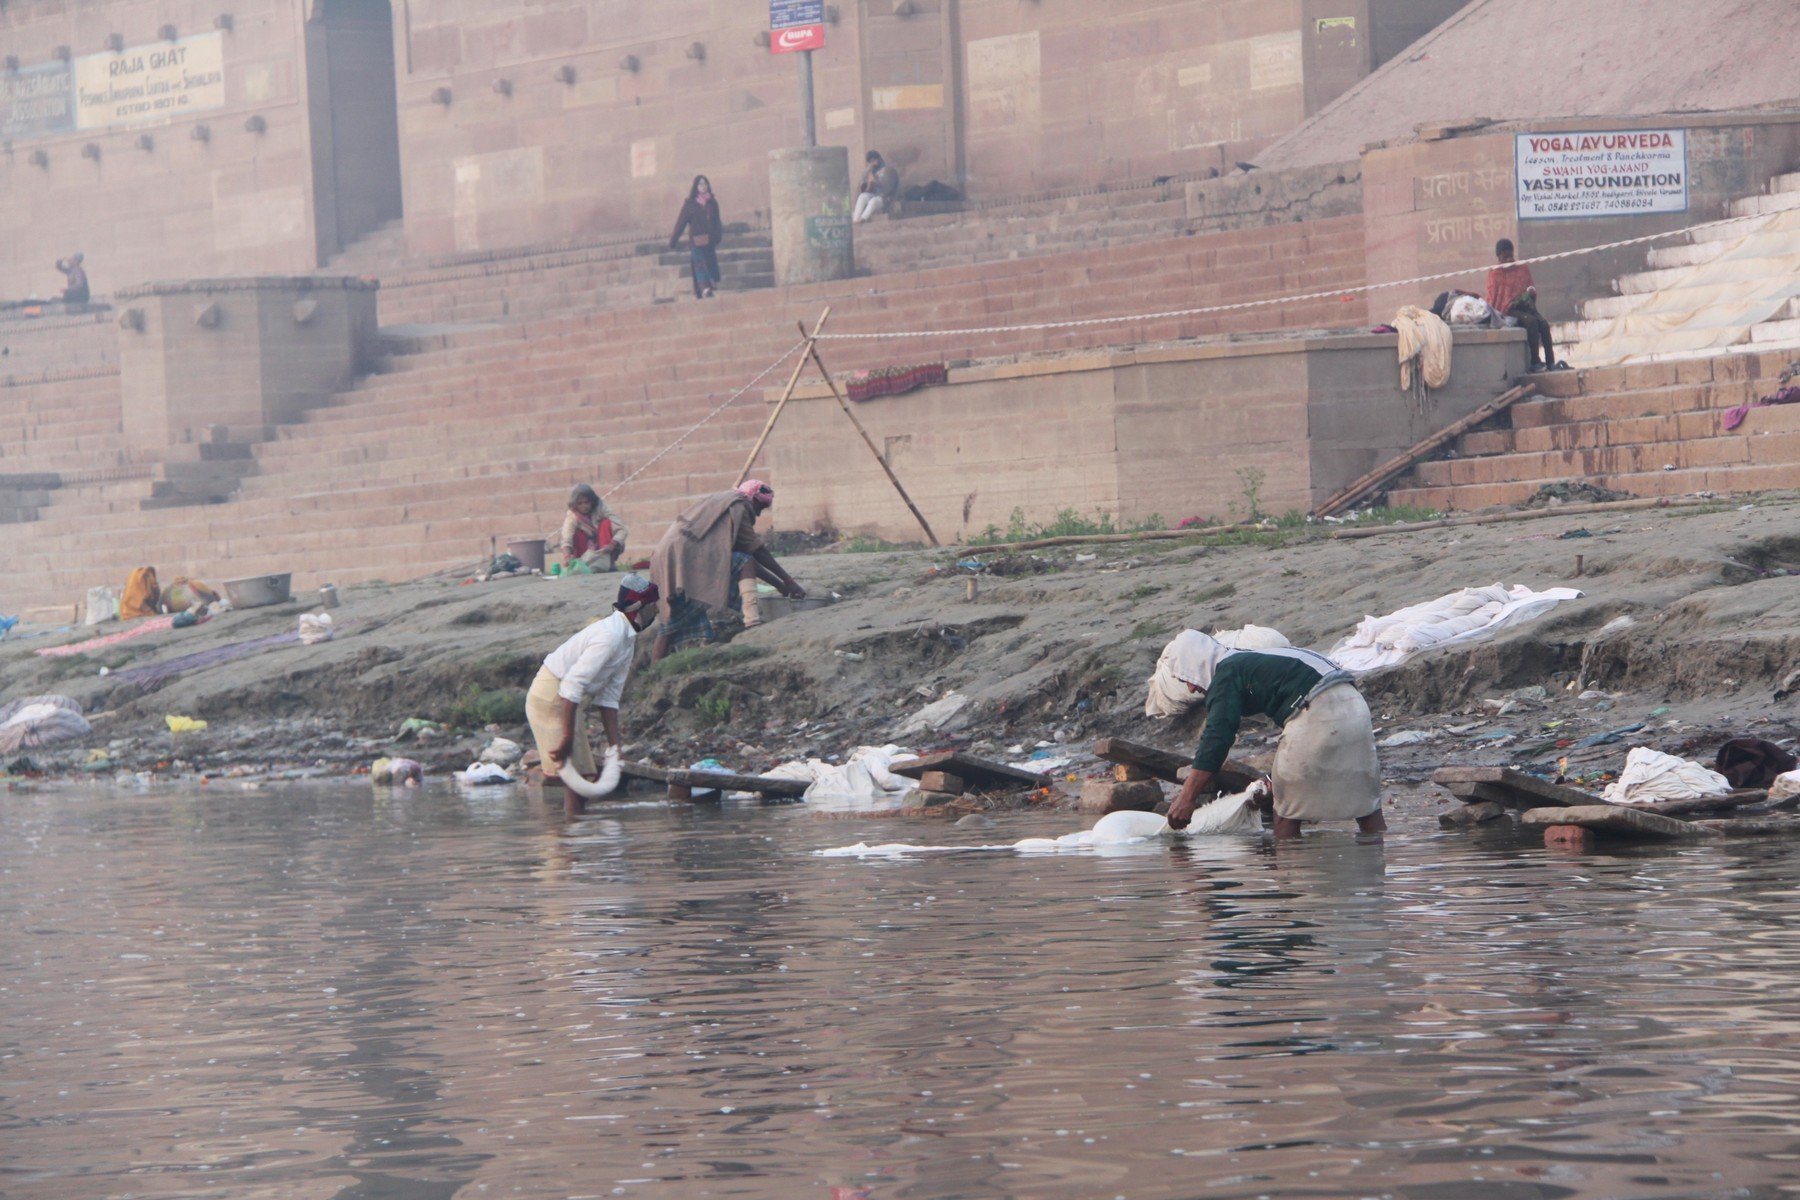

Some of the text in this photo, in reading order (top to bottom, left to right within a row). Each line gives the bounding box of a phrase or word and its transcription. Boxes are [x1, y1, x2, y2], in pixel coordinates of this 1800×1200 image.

[787, 30, 813, 40] RUPA
[109, 46, 187, 78] RAJA GHAT
[1562, 152, 1605, 163] Treatment
[1607, 152, 1613, 162] &
[1542, 162, 1650, 177] SWAMI YOG-ANAND
[1523, 173, 1681, 191] YASH FOUNDATION
